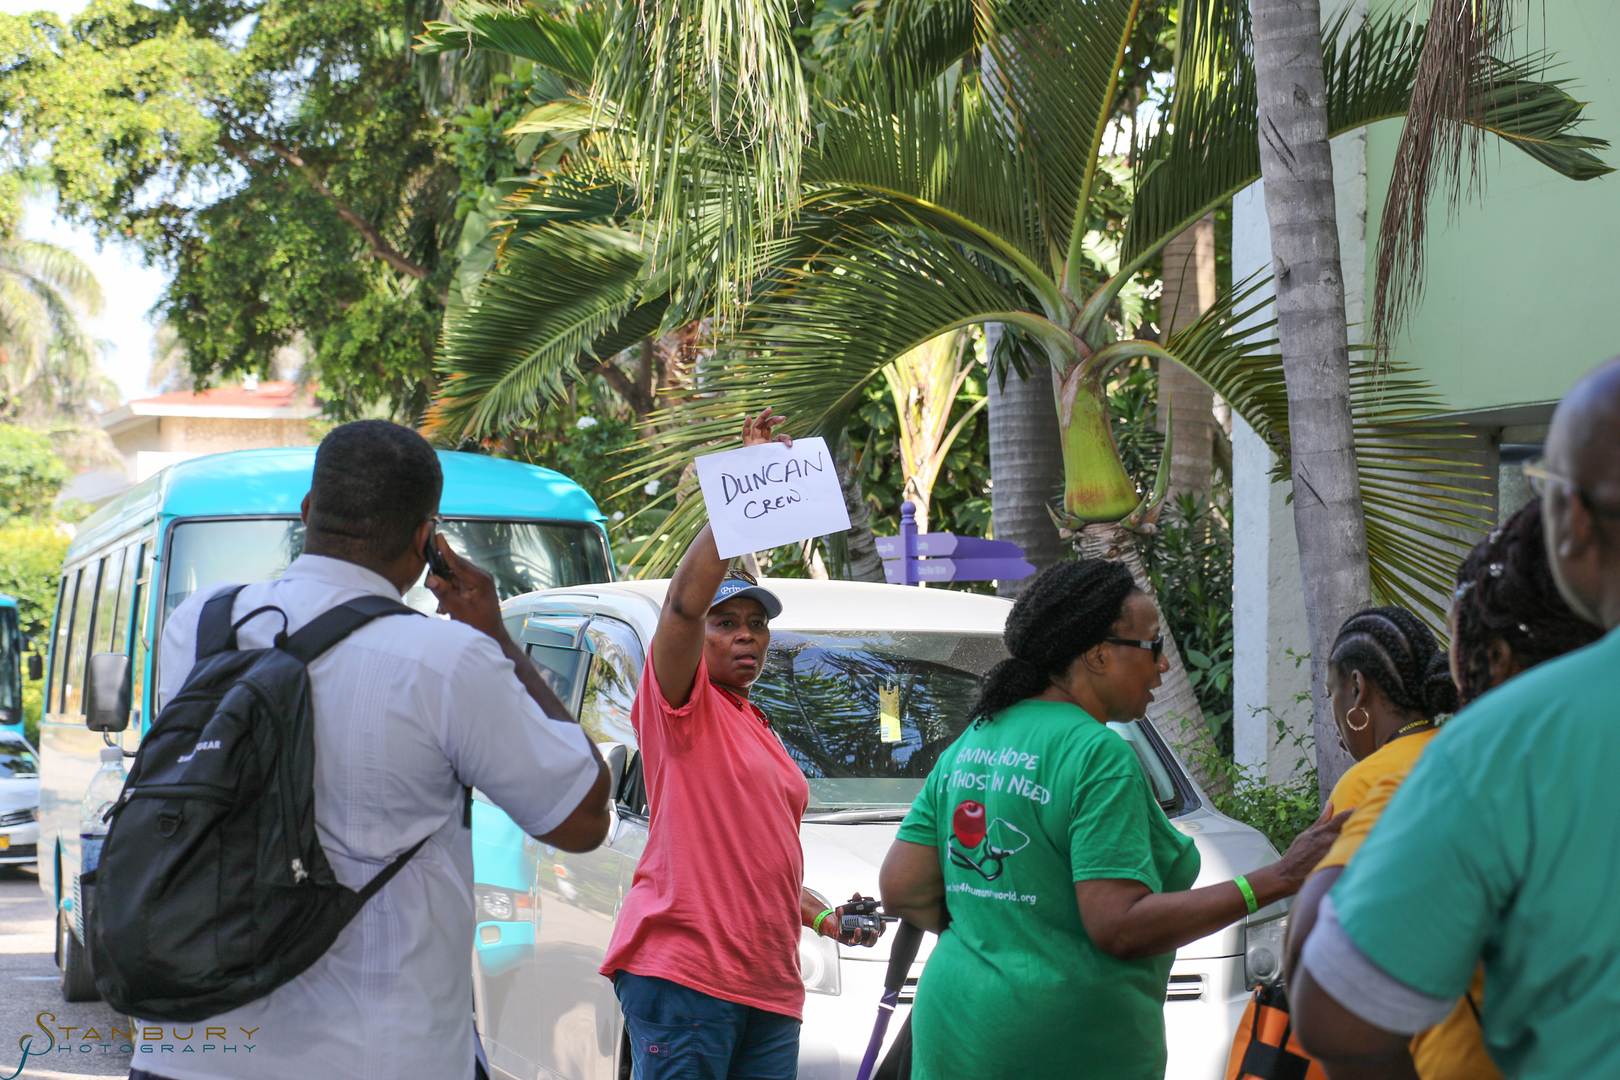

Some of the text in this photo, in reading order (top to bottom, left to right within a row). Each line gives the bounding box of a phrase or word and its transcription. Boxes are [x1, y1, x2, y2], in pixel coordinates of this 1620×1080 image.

[721, 451, 823, 505] DUNCAN
[720, 584, 742, 595] Prin
[998, 747, 1040, 771] HOPE
[1006, 774, 1050, 805] NEED
